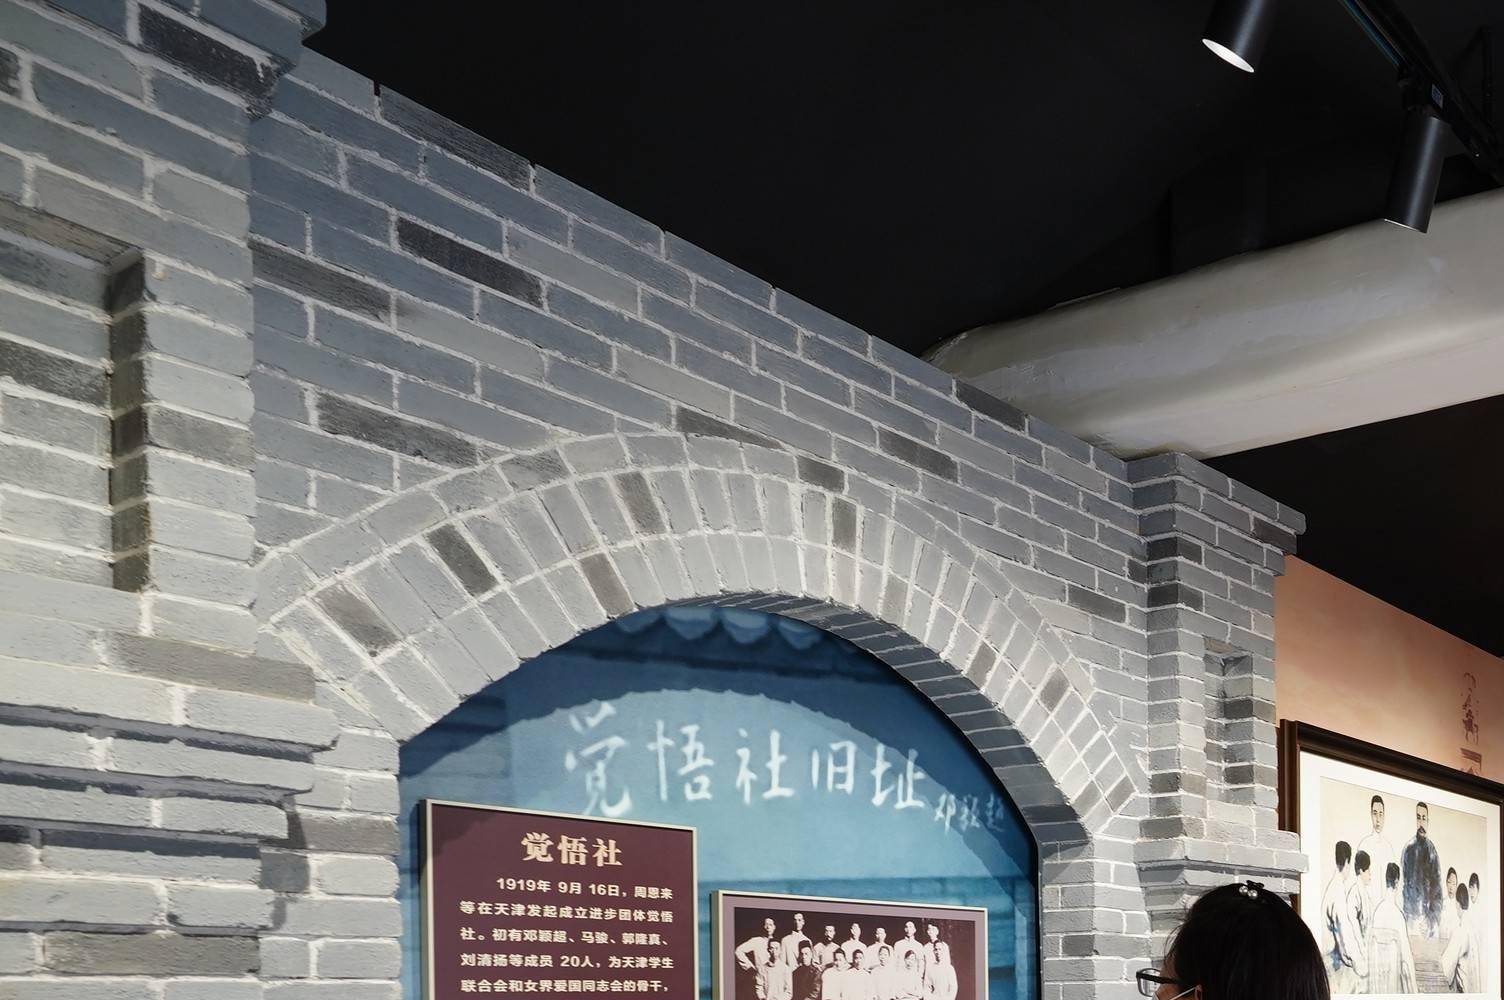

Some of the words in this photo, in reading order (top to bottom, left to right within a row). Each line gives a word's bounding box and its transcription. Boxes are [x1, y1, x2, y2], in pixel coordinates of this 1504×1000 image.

[565, 701, 925, 818] 觉悟社旧址
[521, 832, 623, 867] 觉悟社
[459, 900, 673, 923] 等在天津发起成立进步团体觉悟
